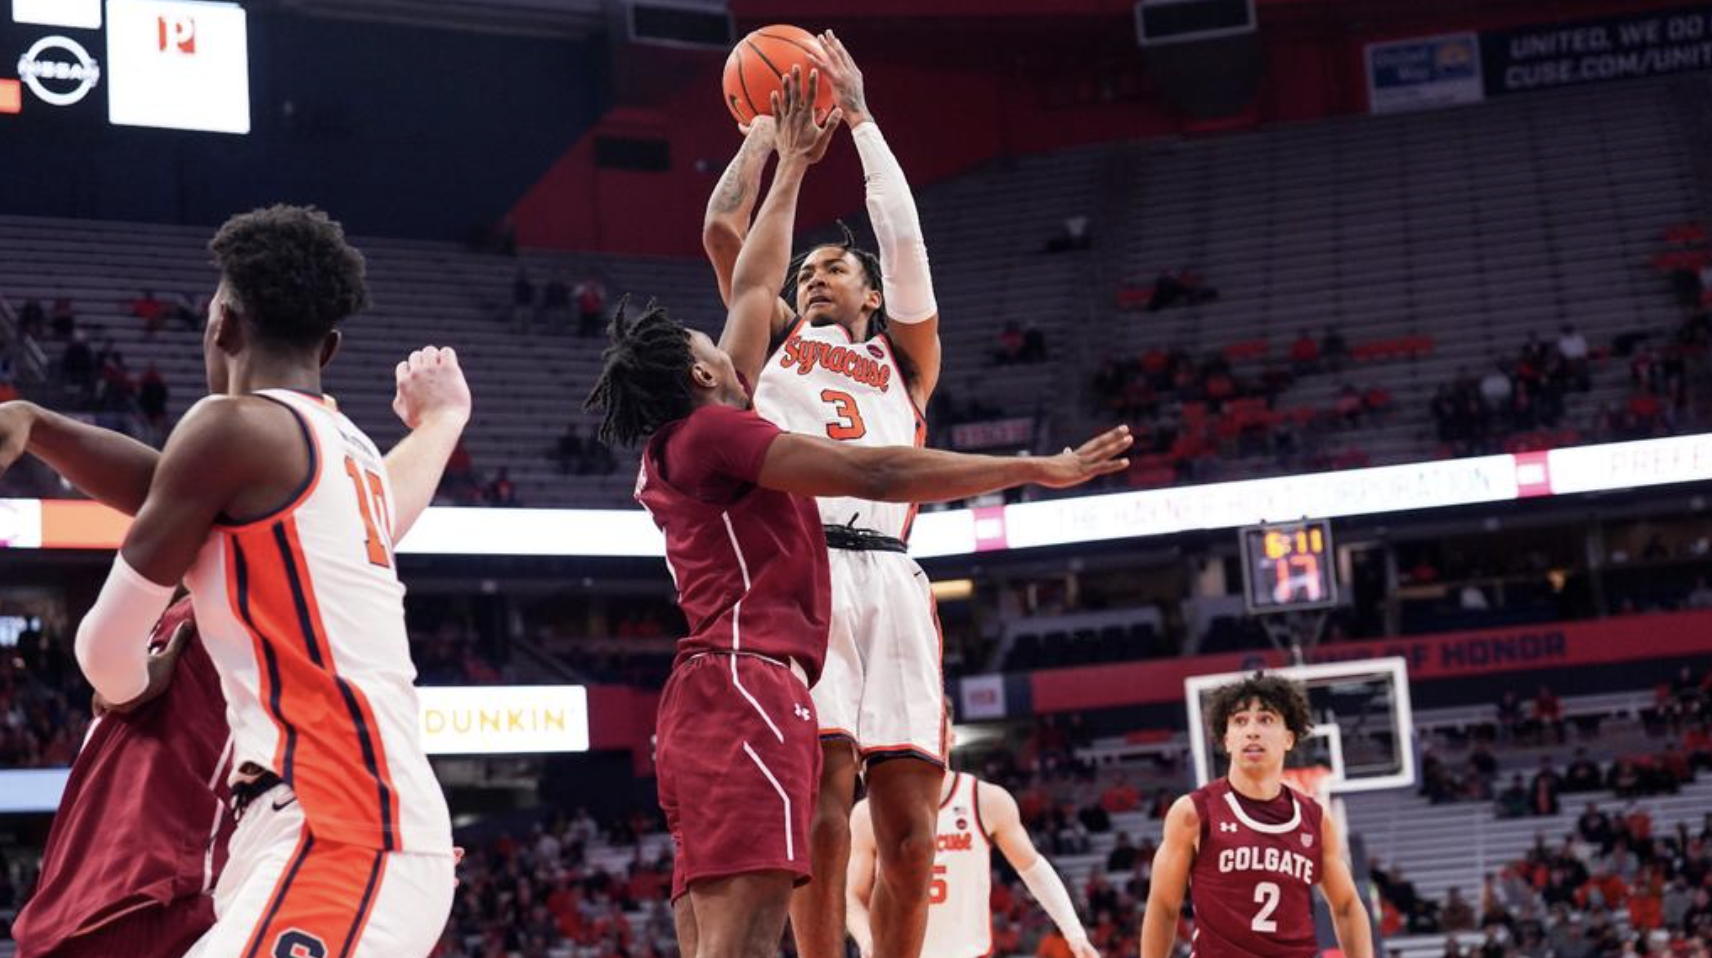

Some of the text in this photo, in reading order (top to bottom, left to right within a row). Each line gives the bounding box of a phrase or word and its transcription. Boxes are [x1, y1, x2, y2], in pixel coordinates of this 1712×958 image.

[1619, 18, 1662, 45] WE
[1667, 14, 1704, 41] DO
[780, 334, 891, 392] Syracuse
[821, 389, 866, 441] 3
[1440, 630, 1565, 667] HONOR
[1218, 846, 1314, 885] COLGATE
[1251, 881, 1281, 932] 2
